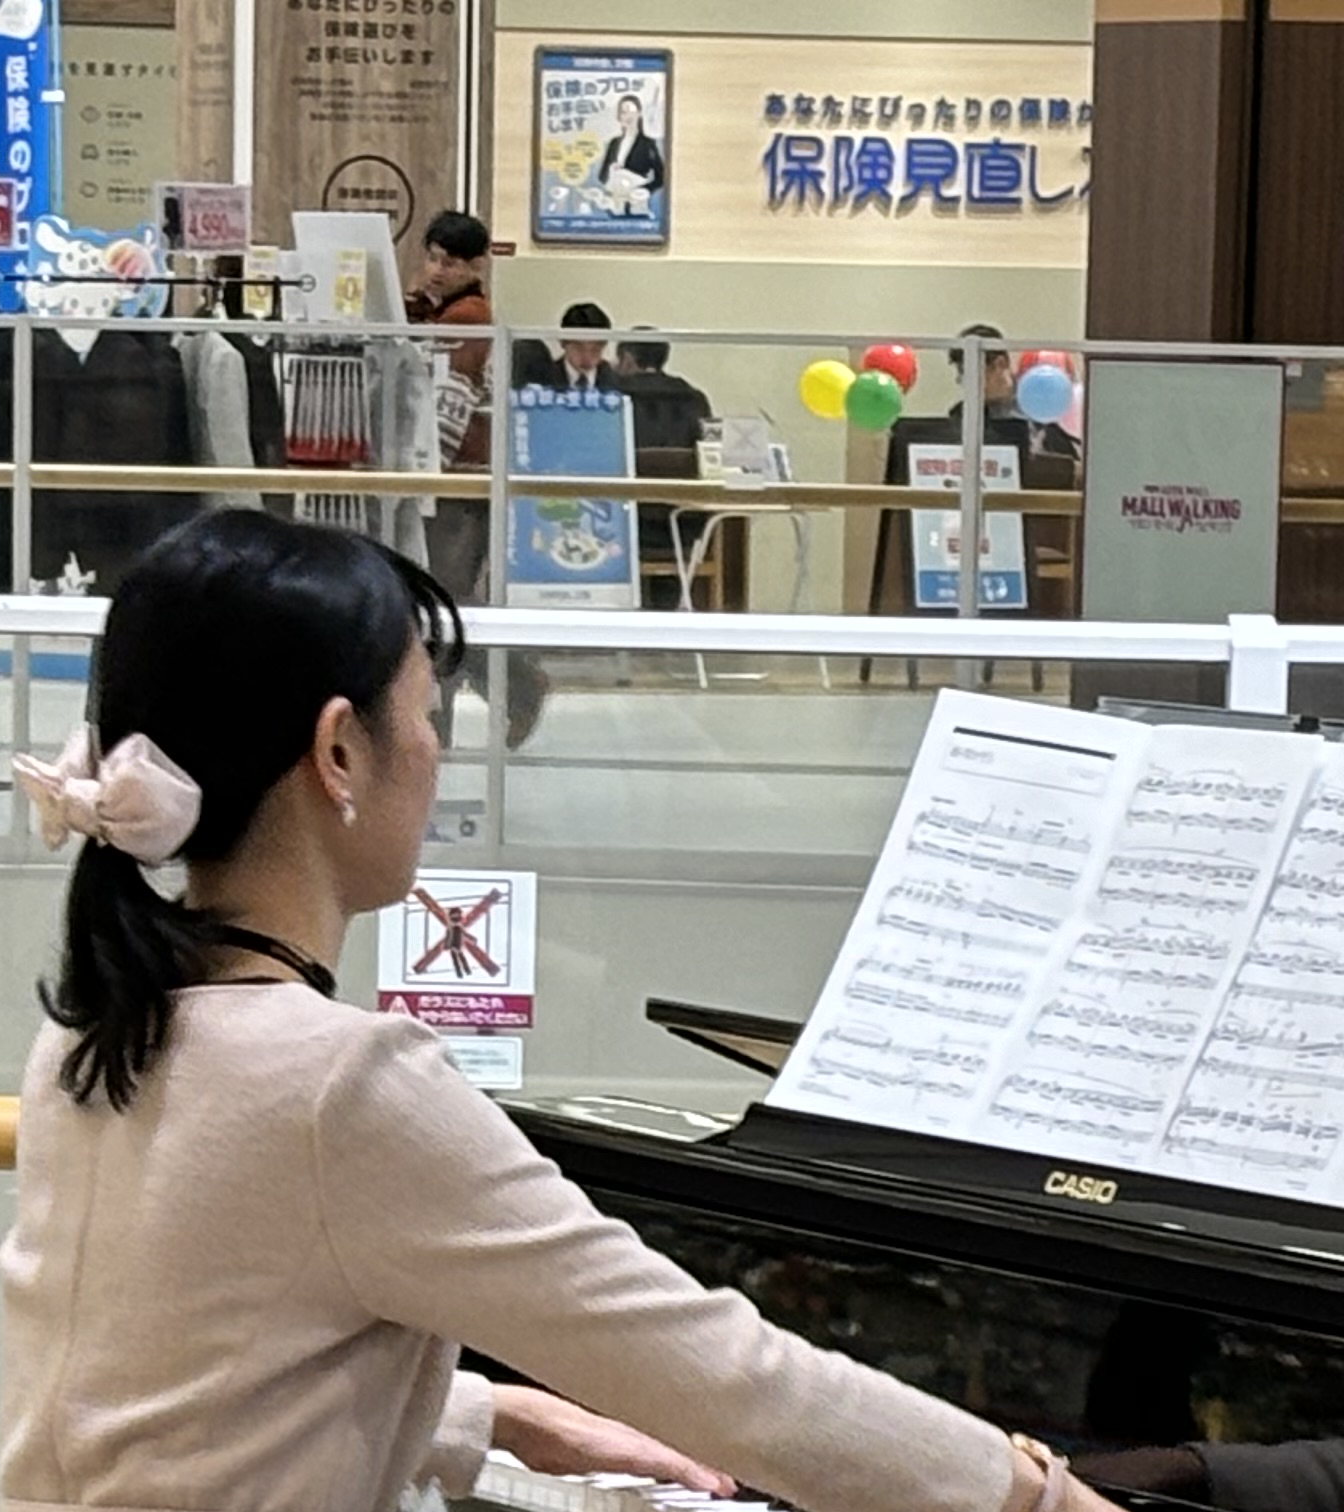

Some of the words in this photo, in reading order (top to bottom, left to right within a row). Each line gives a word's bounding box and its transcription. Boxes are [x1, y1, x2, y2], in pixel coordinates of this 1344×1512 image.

[306, 48, 434, 65] お手伝いします
[548, 117, 587, 133] します
[1044, 1170, 1118, 1204] CASIO
